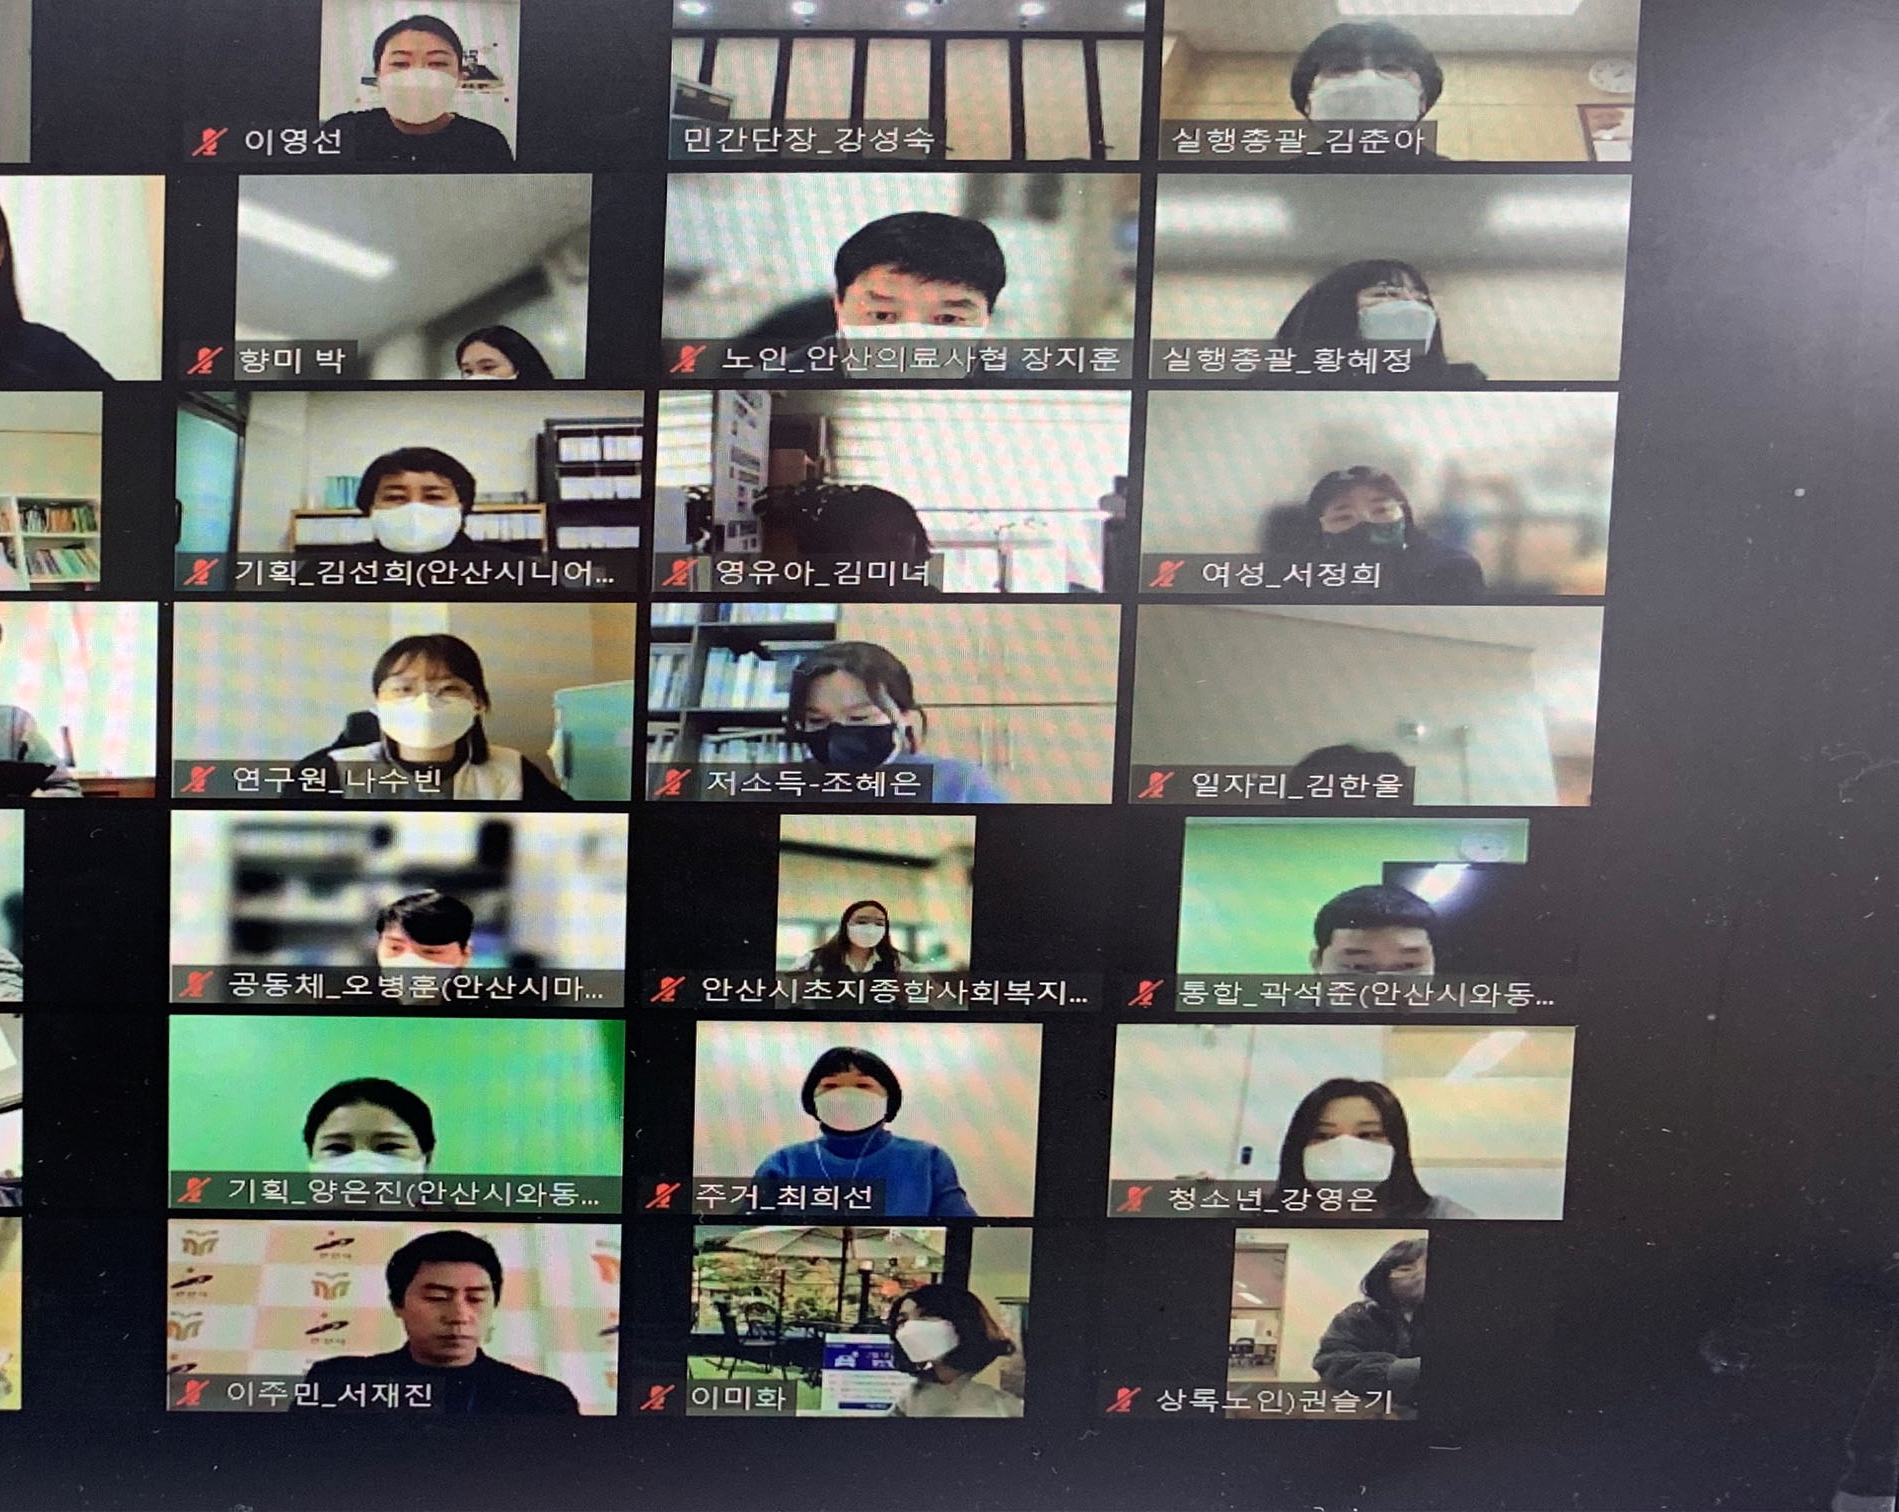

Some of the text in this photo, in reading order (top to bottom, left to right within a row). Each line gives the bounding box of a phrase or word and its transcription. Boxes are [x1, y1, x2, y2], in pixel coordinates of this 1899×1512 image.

[244, 126, 343, 156] 이영선
[684, 124, 936, 156] 민간단장_강성숙
[1172, 126, 1425, 157] 실행총괄_김춘아
[317, 344, 347, 375] 박
[721, 344, 1121, 374] 노인_안산의료사협 장지훈
[1162, 345, 1413, 376] 실행총괄_황혜정
[1202, 560, 1382, 590] 여성_서정희
[232, 764, 442, 796] 연구원_나수빈
[707, 768, 918, 799] 저소득-조혜은
[1191, 770, 1404, 801] 일자리_김한울
[702, 973, 1089, 1006] 안산시초지종합사회복지...
[696, 1182, 873, 1213] 주거_최희선
[1168, 1184, 1378, 1213] 청소년_강영은
[227, 1378, 434, 1411] 이주민_서재진
[692, 1382, 786, 1412] 이미화
[1157, 1386, 1394, 1417] 상록노인)권슬기
